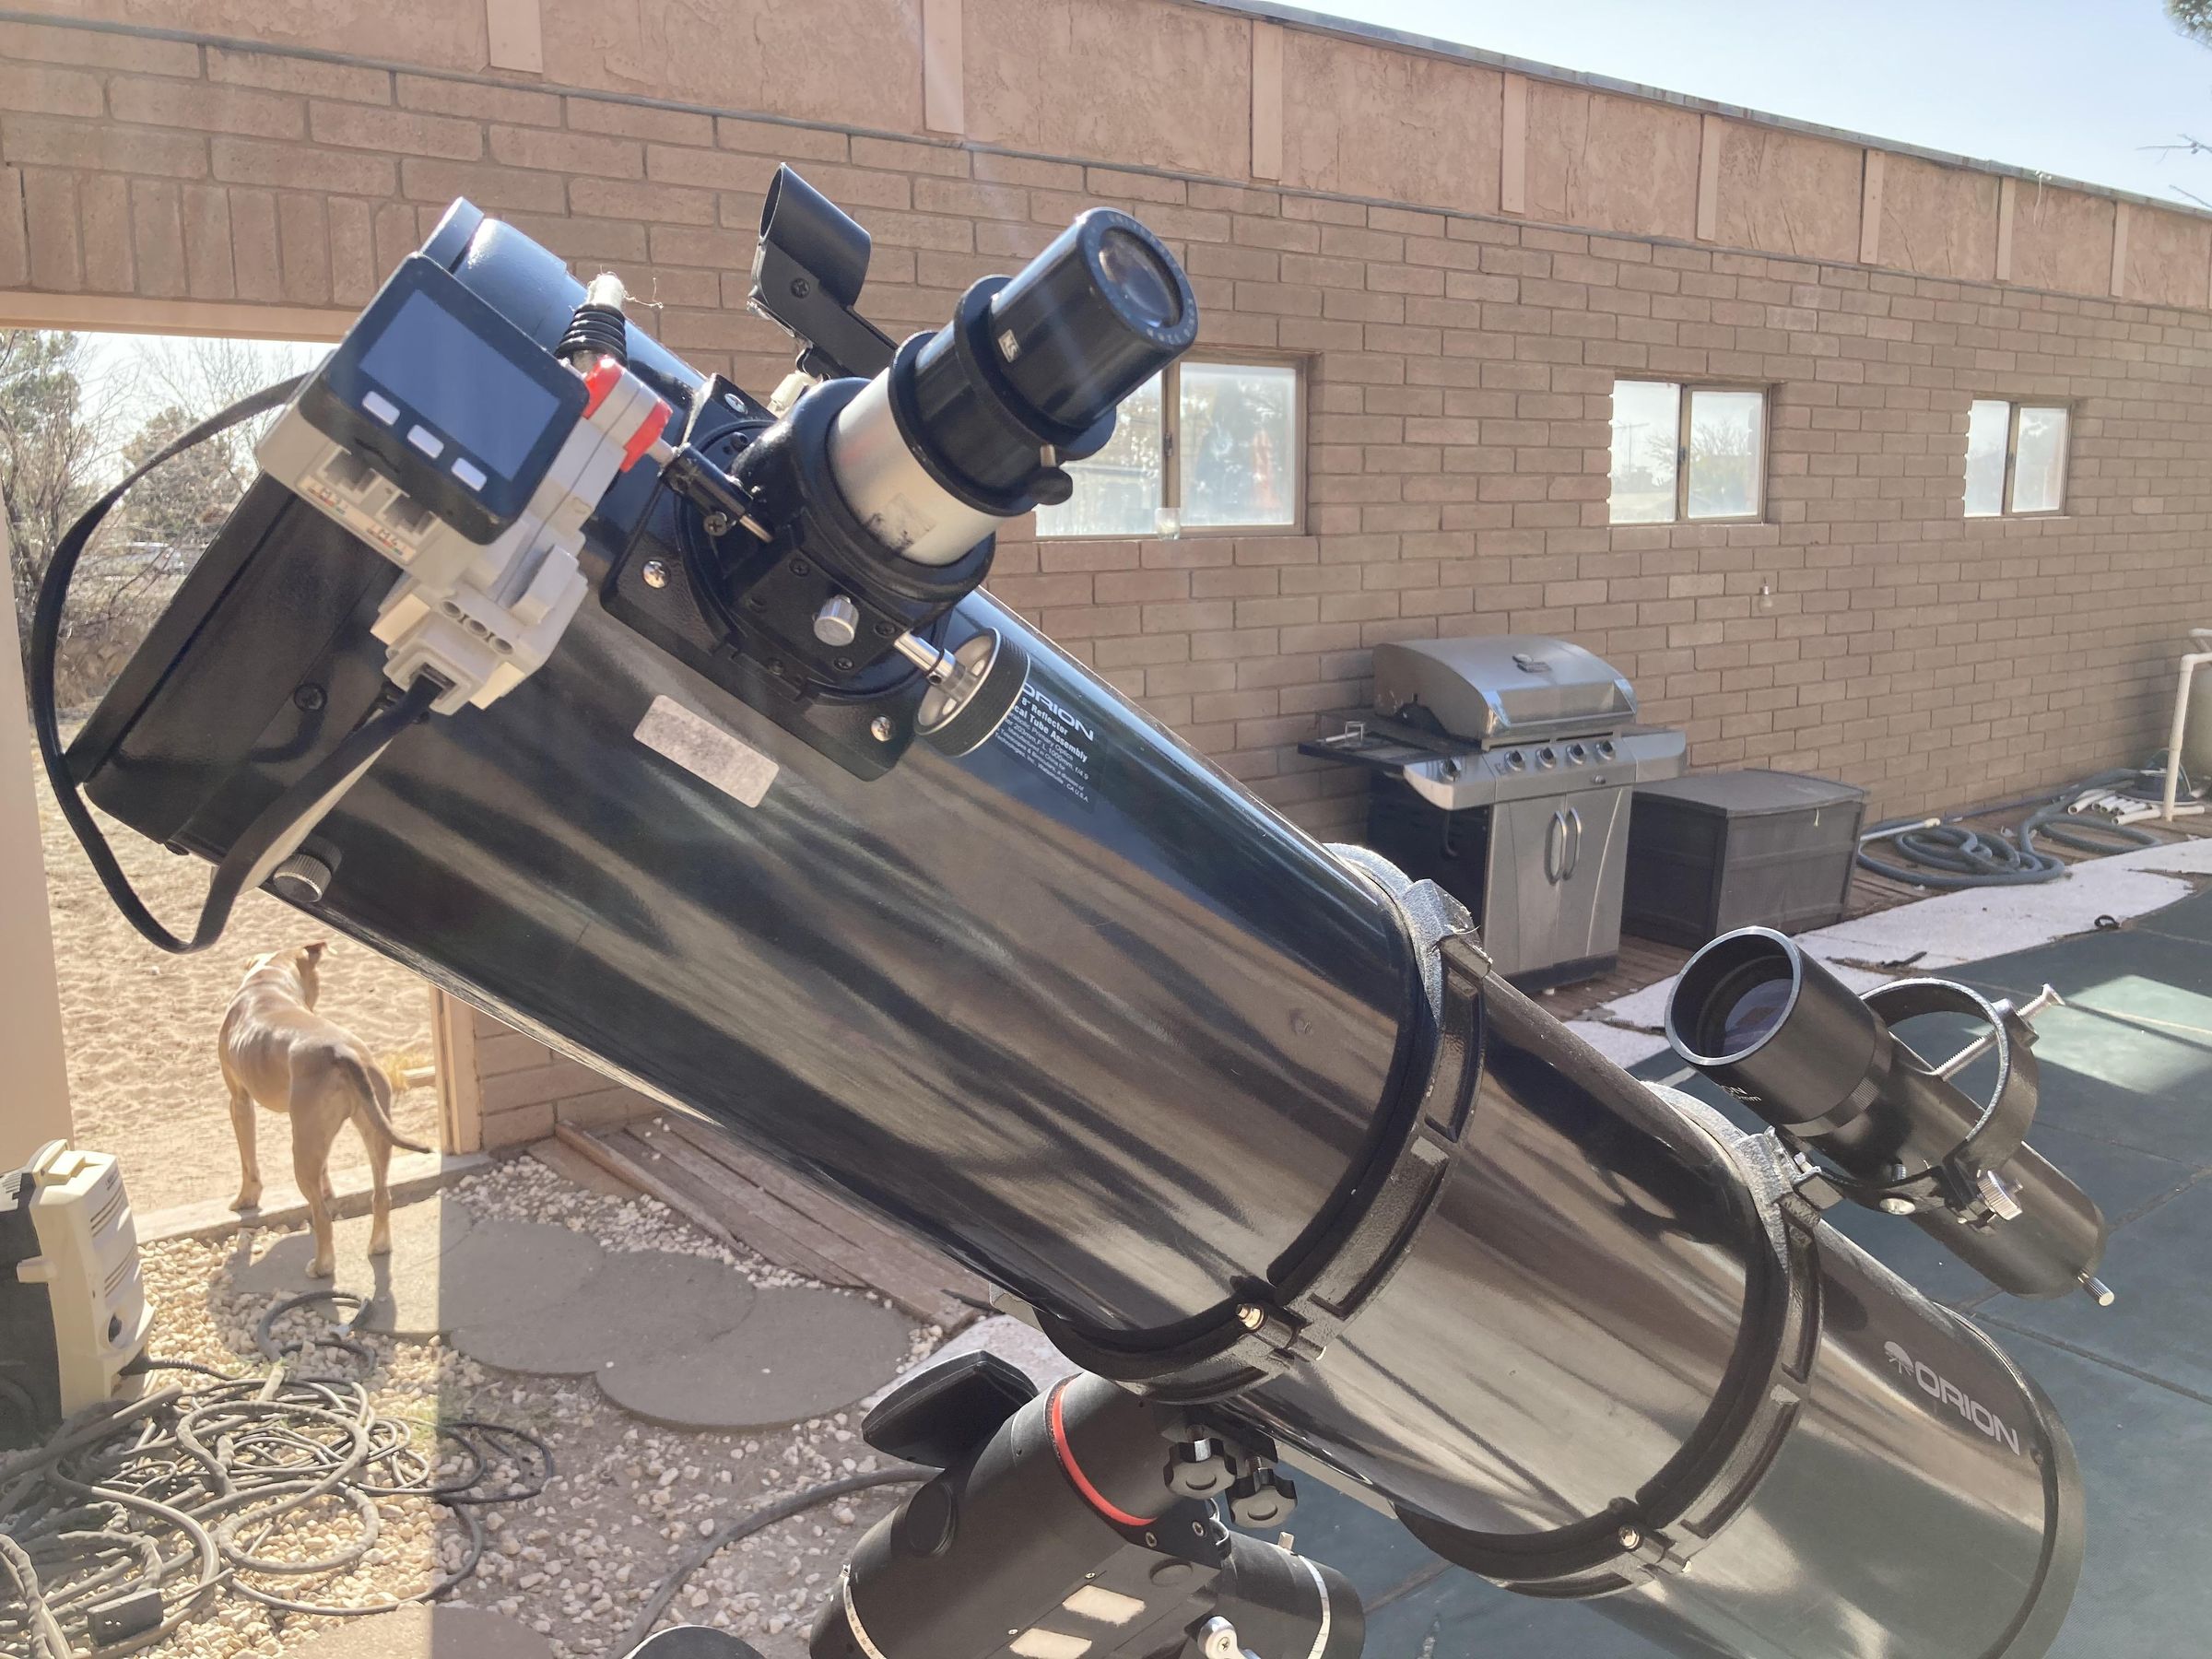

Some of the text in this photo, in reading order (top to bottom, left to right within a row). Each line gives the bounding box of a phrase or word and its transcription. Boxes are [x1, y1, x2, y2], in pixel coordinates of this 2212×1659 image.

[1022, 682, 1095, 742] ORION
[1031, 703, 1068, 735] Reflector
[1030, 713, 1049, 735] Tube
[1050, 730, 1088, 763] Assembly
[1031, 726, 1054, 747] Primary
[1054, 744, 1074, 761] Optics
[1045, 753, 1059, 766] China
[1915, 1361, 2020, 1456] ORION
